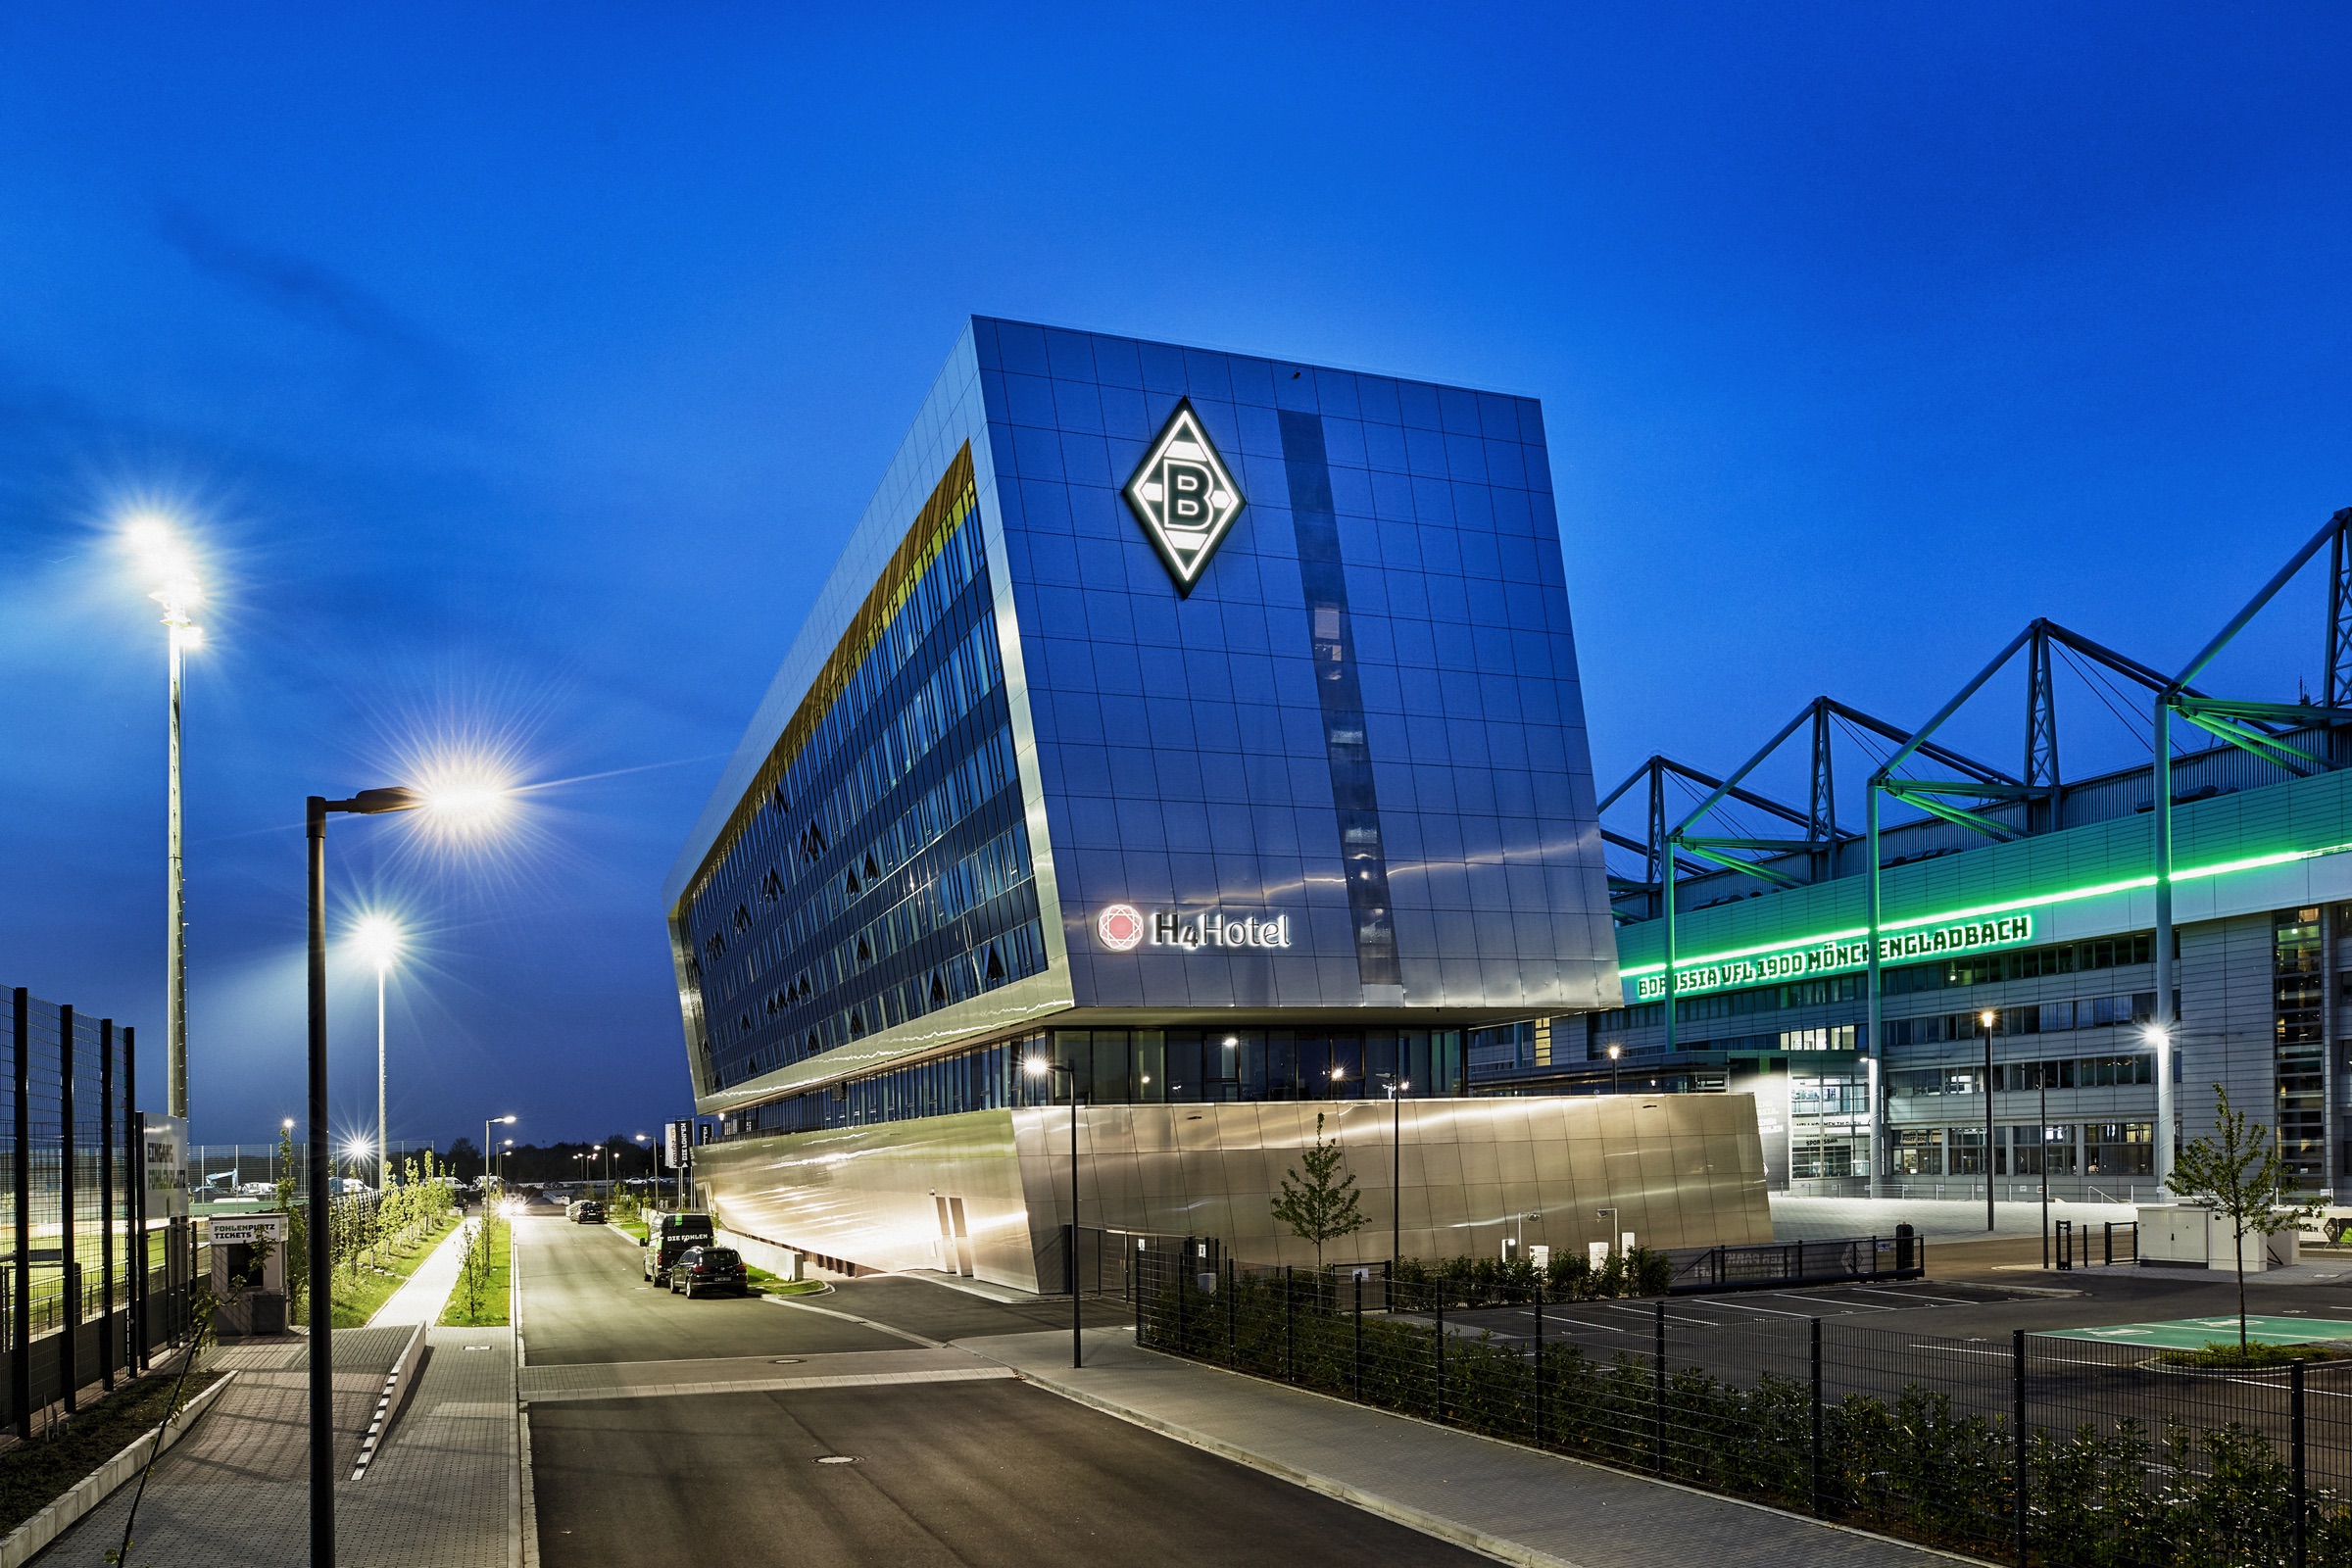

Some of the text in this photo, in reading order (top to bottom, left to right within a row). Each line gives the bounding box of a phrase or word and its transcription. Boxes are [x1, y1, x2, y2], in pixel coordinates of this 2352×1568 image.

[1162, 459, 1214, 530] B
[1153, 910, 1291, 948] H4Hotel
[1721, 962, 1754, 984] VFL
[1757, 955, 1802, 978] 1900
[1806, 1138, 1838, 1147] SPORSBAR
[214, 1223, 275, 1233] FOHLENPLTZ
[214, 1231, 252, 1240] TICKETS
[681, 1233, 709, 1242] FOHLEN
